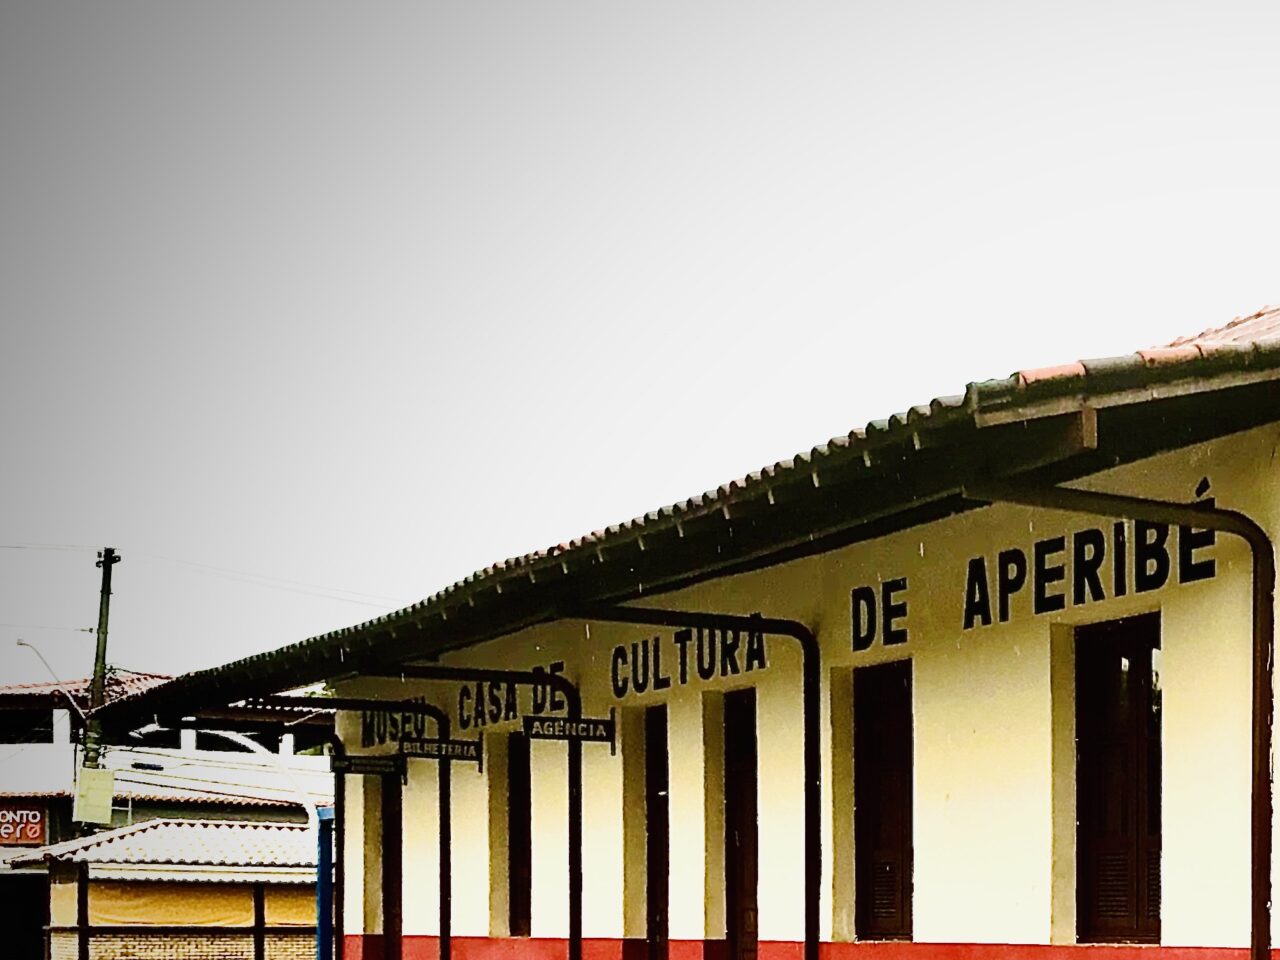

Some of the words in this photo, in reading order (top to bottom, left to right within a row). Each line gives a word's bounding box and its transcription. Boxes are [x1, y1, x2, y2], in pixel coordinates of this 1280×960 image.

[361, 697, 425, 748] MUSEU
[458, 679, 518, 730] CASA
[532, 661, 565, 715] DE
[611, 613, 767, 699] CULTURA
[852, 578, 908, 652] DE
[963, 477, 1216, 630] APERIBÉ
[403, 742, 477, 757] BILHETERIA
